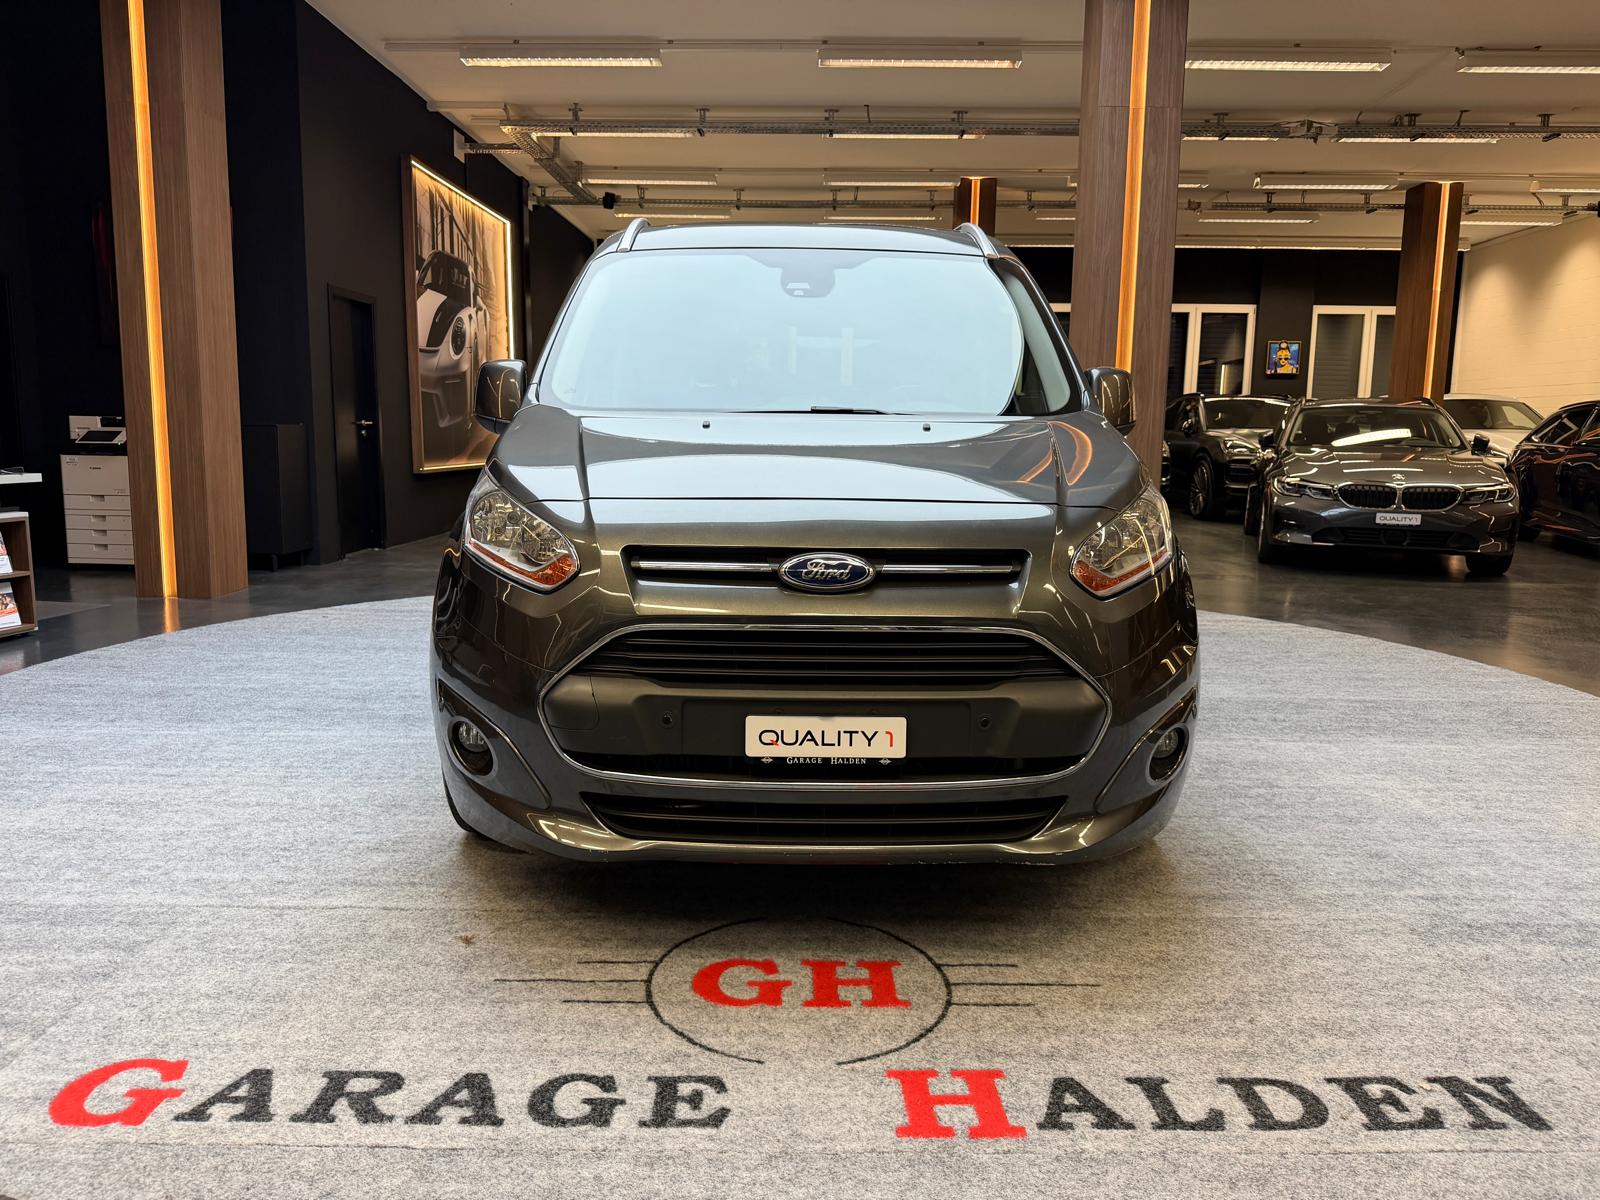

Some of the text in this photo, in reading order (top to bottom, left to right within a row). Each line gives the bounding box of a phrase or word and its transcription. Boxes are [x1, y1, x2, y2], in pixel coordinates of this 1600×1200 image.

[801, 558, 852, 581] Ford
[786, 757, 867, 765] GARAGE HALDEN
[48, 1057, 1554, 1140] GARAGE HALDEN
